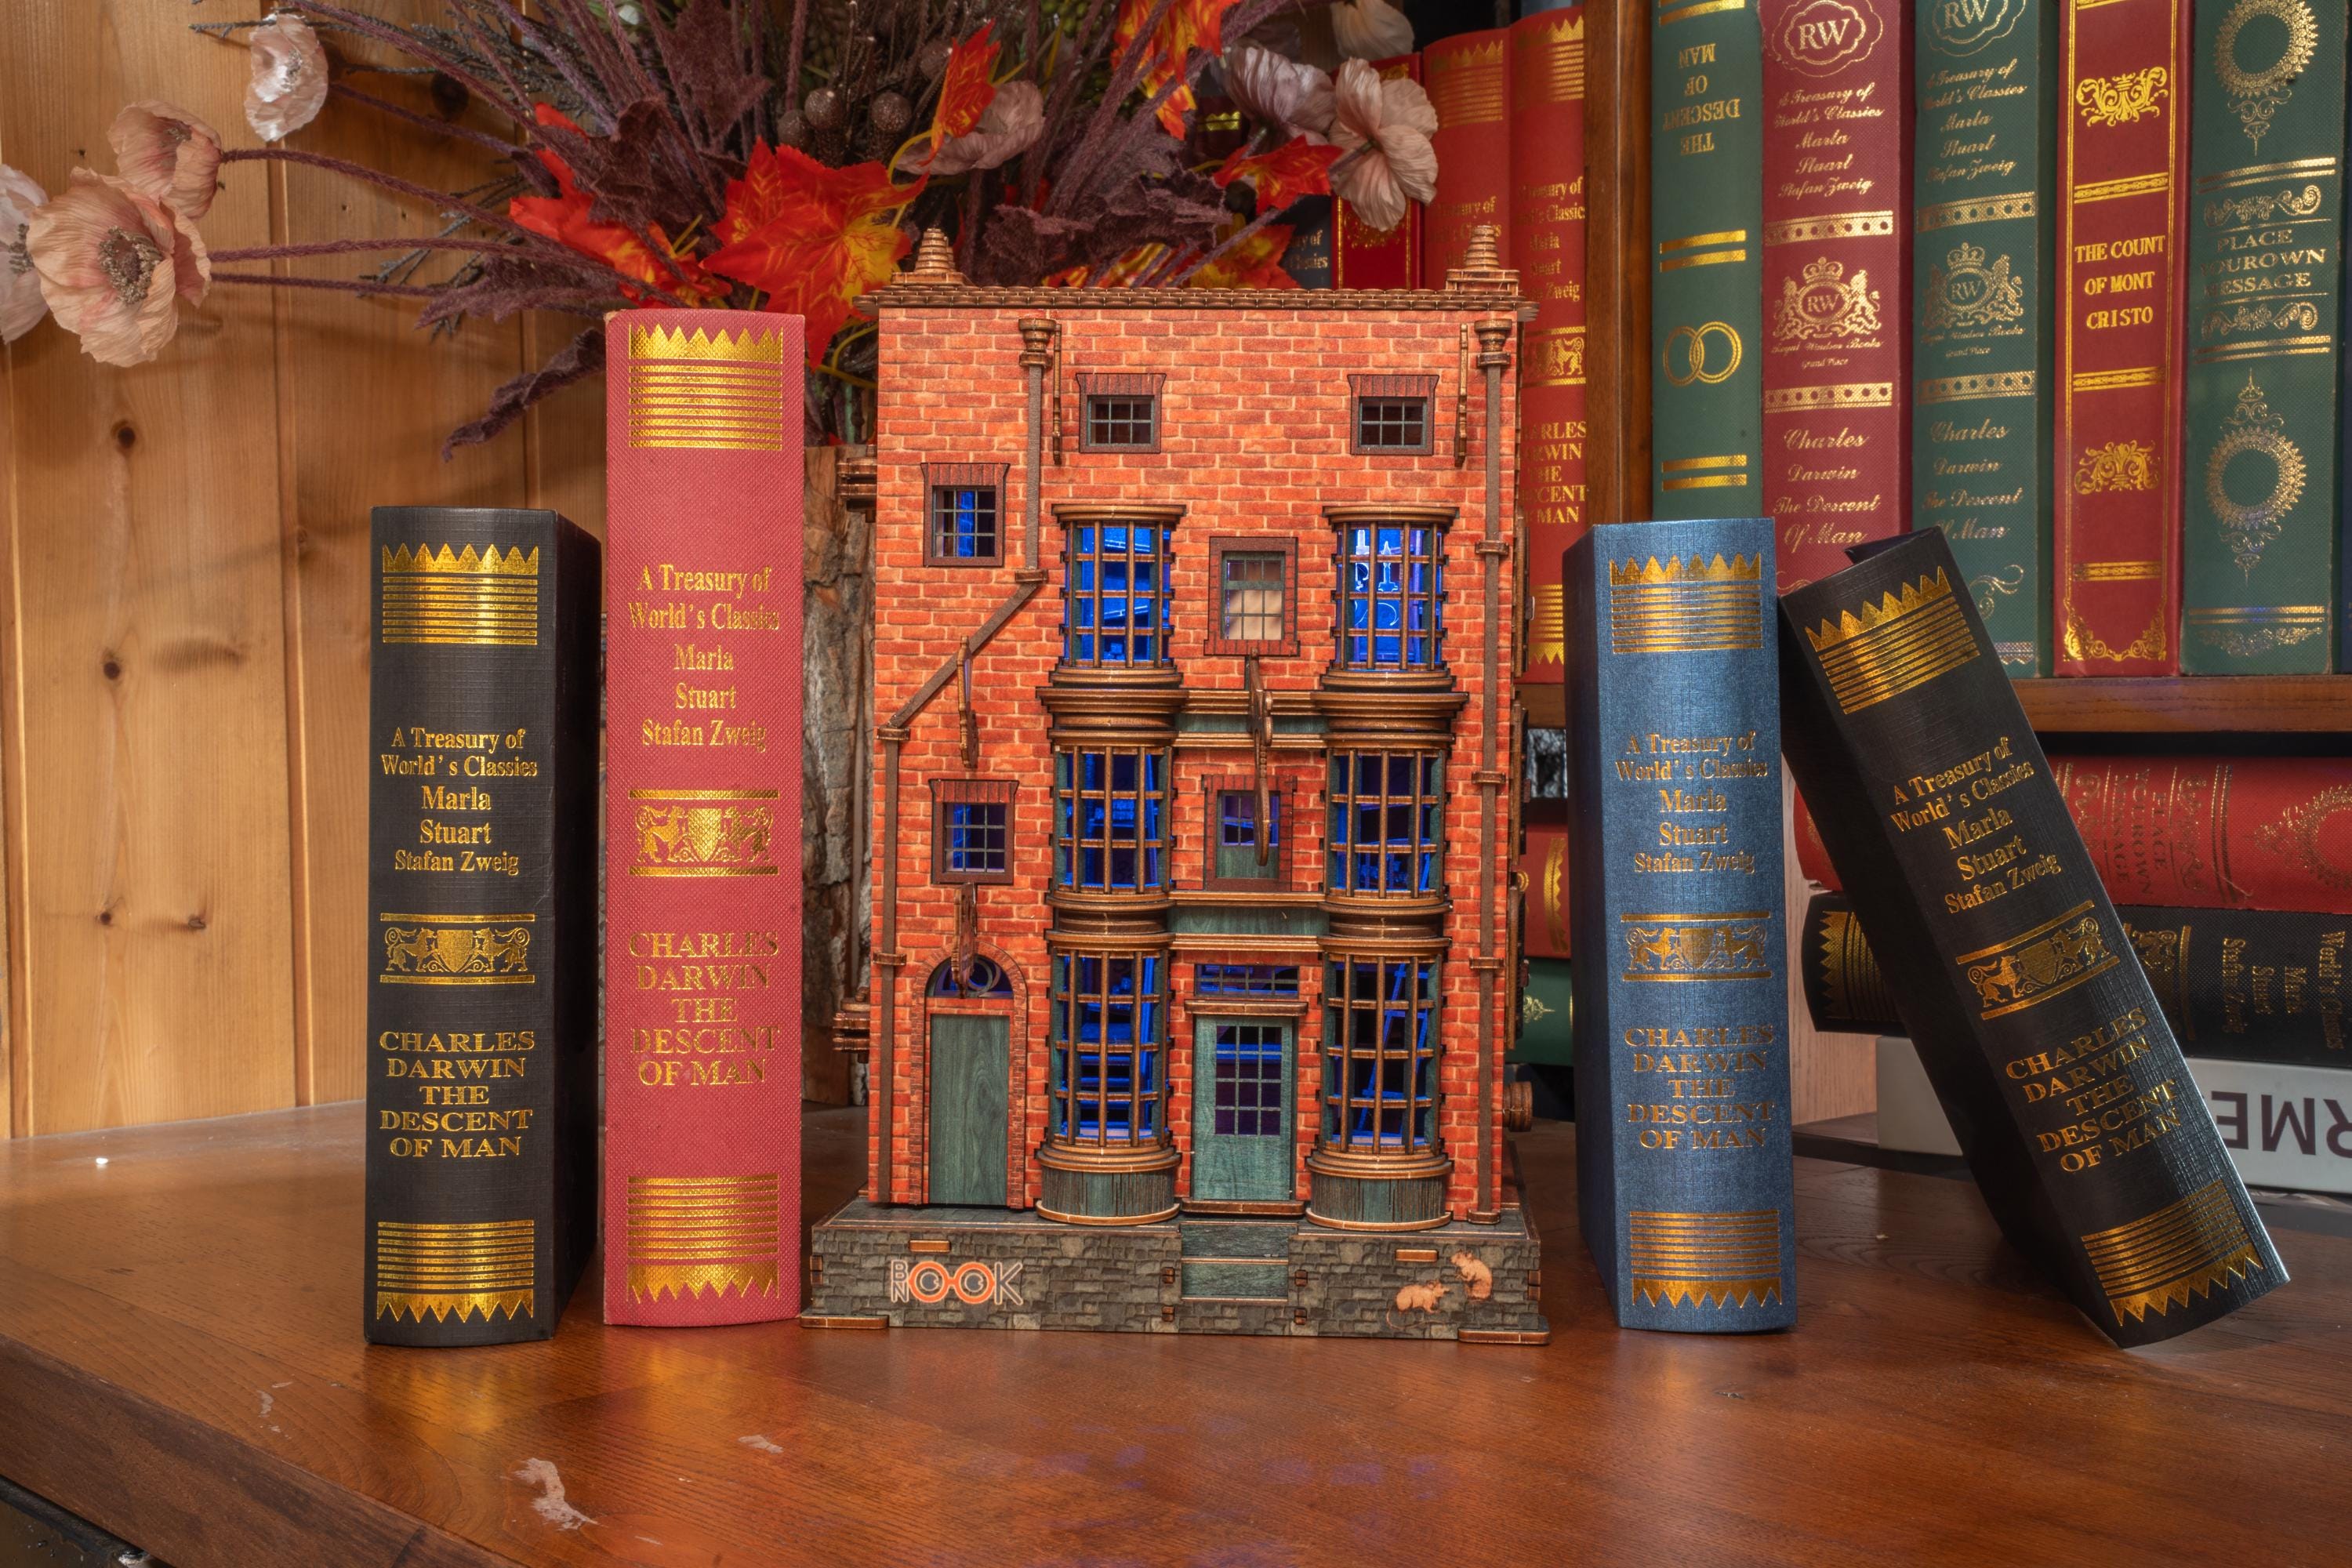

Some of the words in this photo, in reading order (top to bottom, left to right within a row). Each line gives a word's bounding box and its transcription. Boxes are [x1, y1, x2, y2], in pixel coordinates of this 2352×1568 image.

[1944, 0, 1990, 29] RW
[1798, 18, 1850, 50] RW
[1679, 43, 1716, 69] MAN
[1998, 58, 2018, 79] of
[1685, 75, 1708, 96] OF
[1791, 89, 1853, 103] Treasury
[1857, 82, 1875, 102] of
[1663, 98, 1740, 131] DESCENT
[1681, 132, 1715, 155] THE
[1570, 176, 1584, 194] of
[1483, 196, 1497, 213] of
[2074, 243, 2107, 263] THE
[2111, 235, 2165, 259] COUNT
[2216, 229, 2293, 252] PLACE
[1951, 280, 1982, 300] RW
[2085, 277, 2107, 296] OF
[2111, 271, 2155, 293] MONT
[1806, 294, 1840, 313] RW
[2086, 306, 2154, 329] CRISTO
[1784, 427, 1870, 450] Charles
[1930, 417, 2011, 443] Charles
[1788, 464, 1861, 482] Darwin
[1933, 457, 2002, 475] Darwin
[1537, 506, 1580, 524] MAN
[1773, 496, 1801, 514] The
[1806, 494, 1882, 513] Descent
[1808, 522, 1868, 544] Man
[637, 564, 653, 590] A
[659, 564, 747, 599] Treasury
[752, 565, 771, 591] of
[675, 682, 736, 709] Stuart
[391, 728, 405, 747] A
[411, 727, 499, 753] Treasury
[505, 728, 526, 749] of
[642, 719, 704, 746] Stafan
[710, 720, 767, 753] Zweig
[1626, 735, 1641, 754] A
[1646, 733, 1733, 757] Treasury
[1737, 730, 1756, 750] of
[1893, 784, 1910, 805] A
[1907, 751, 1991, 798] Treasury
[1994, 735, 2013, 760] of
[420, 819, 491, 844] Stuart
[1659, 822, 1729, 846] Stuart
[2151, 792, 2167, 869] PLACE
[395, 850, 453, 870] Stafan
[460, 851, 519, 876] Zweig
[1634, 851, 1693, 873] Stafan
[1700, 850, 1755, 874] Zweig
[1957, 833, 2027, 881] Stuart
[1944, 880, 2008, 914] Stafan
[2006, 854, 2062, 890] Zweig
[629, 932, 779, 957] CHARLES
[635, 964, 771, 990] DARWIN
[671, 998, 738, 1022] THE
[379, 1031, 535, 1052] CHARLES
[630, 1026, 780, 1054] DESCENT
[1624, 1025, 1774, 1047] CHARLES
[2005, 1007, 2147, 1080] CHARLES
[387, 1058, 526, 1079] DARWIN
[639, 1061, 683, 1086] OF
[690, 1058, 766, 1086] MAN
[1633, 1051, 1767, 1073] DARWIN
[2022, 1034, 2151, 1103] DARWIN
[419, 1086, 489, 1105] THE
[1668, 1079, 1736, 1098] THE
[2066, 1075, 2134, 1116] THE
[379, 1109, 533, 1131] DESCENT
[1628, 1101, 1775, 1123] DESCENT
[2037, 1079, 2177, 1152] DESCENT
[390, 1137, 433, 1157] OF
[441, 1136, 521, 1158] MAN
[1639, 1130, 1682, 1149] OF
[1690, 1128, 1766, 1149] MAN
[2060, 1143, 2102, 1172] OF
[2108, 1107, 2182, 1157] MAN
